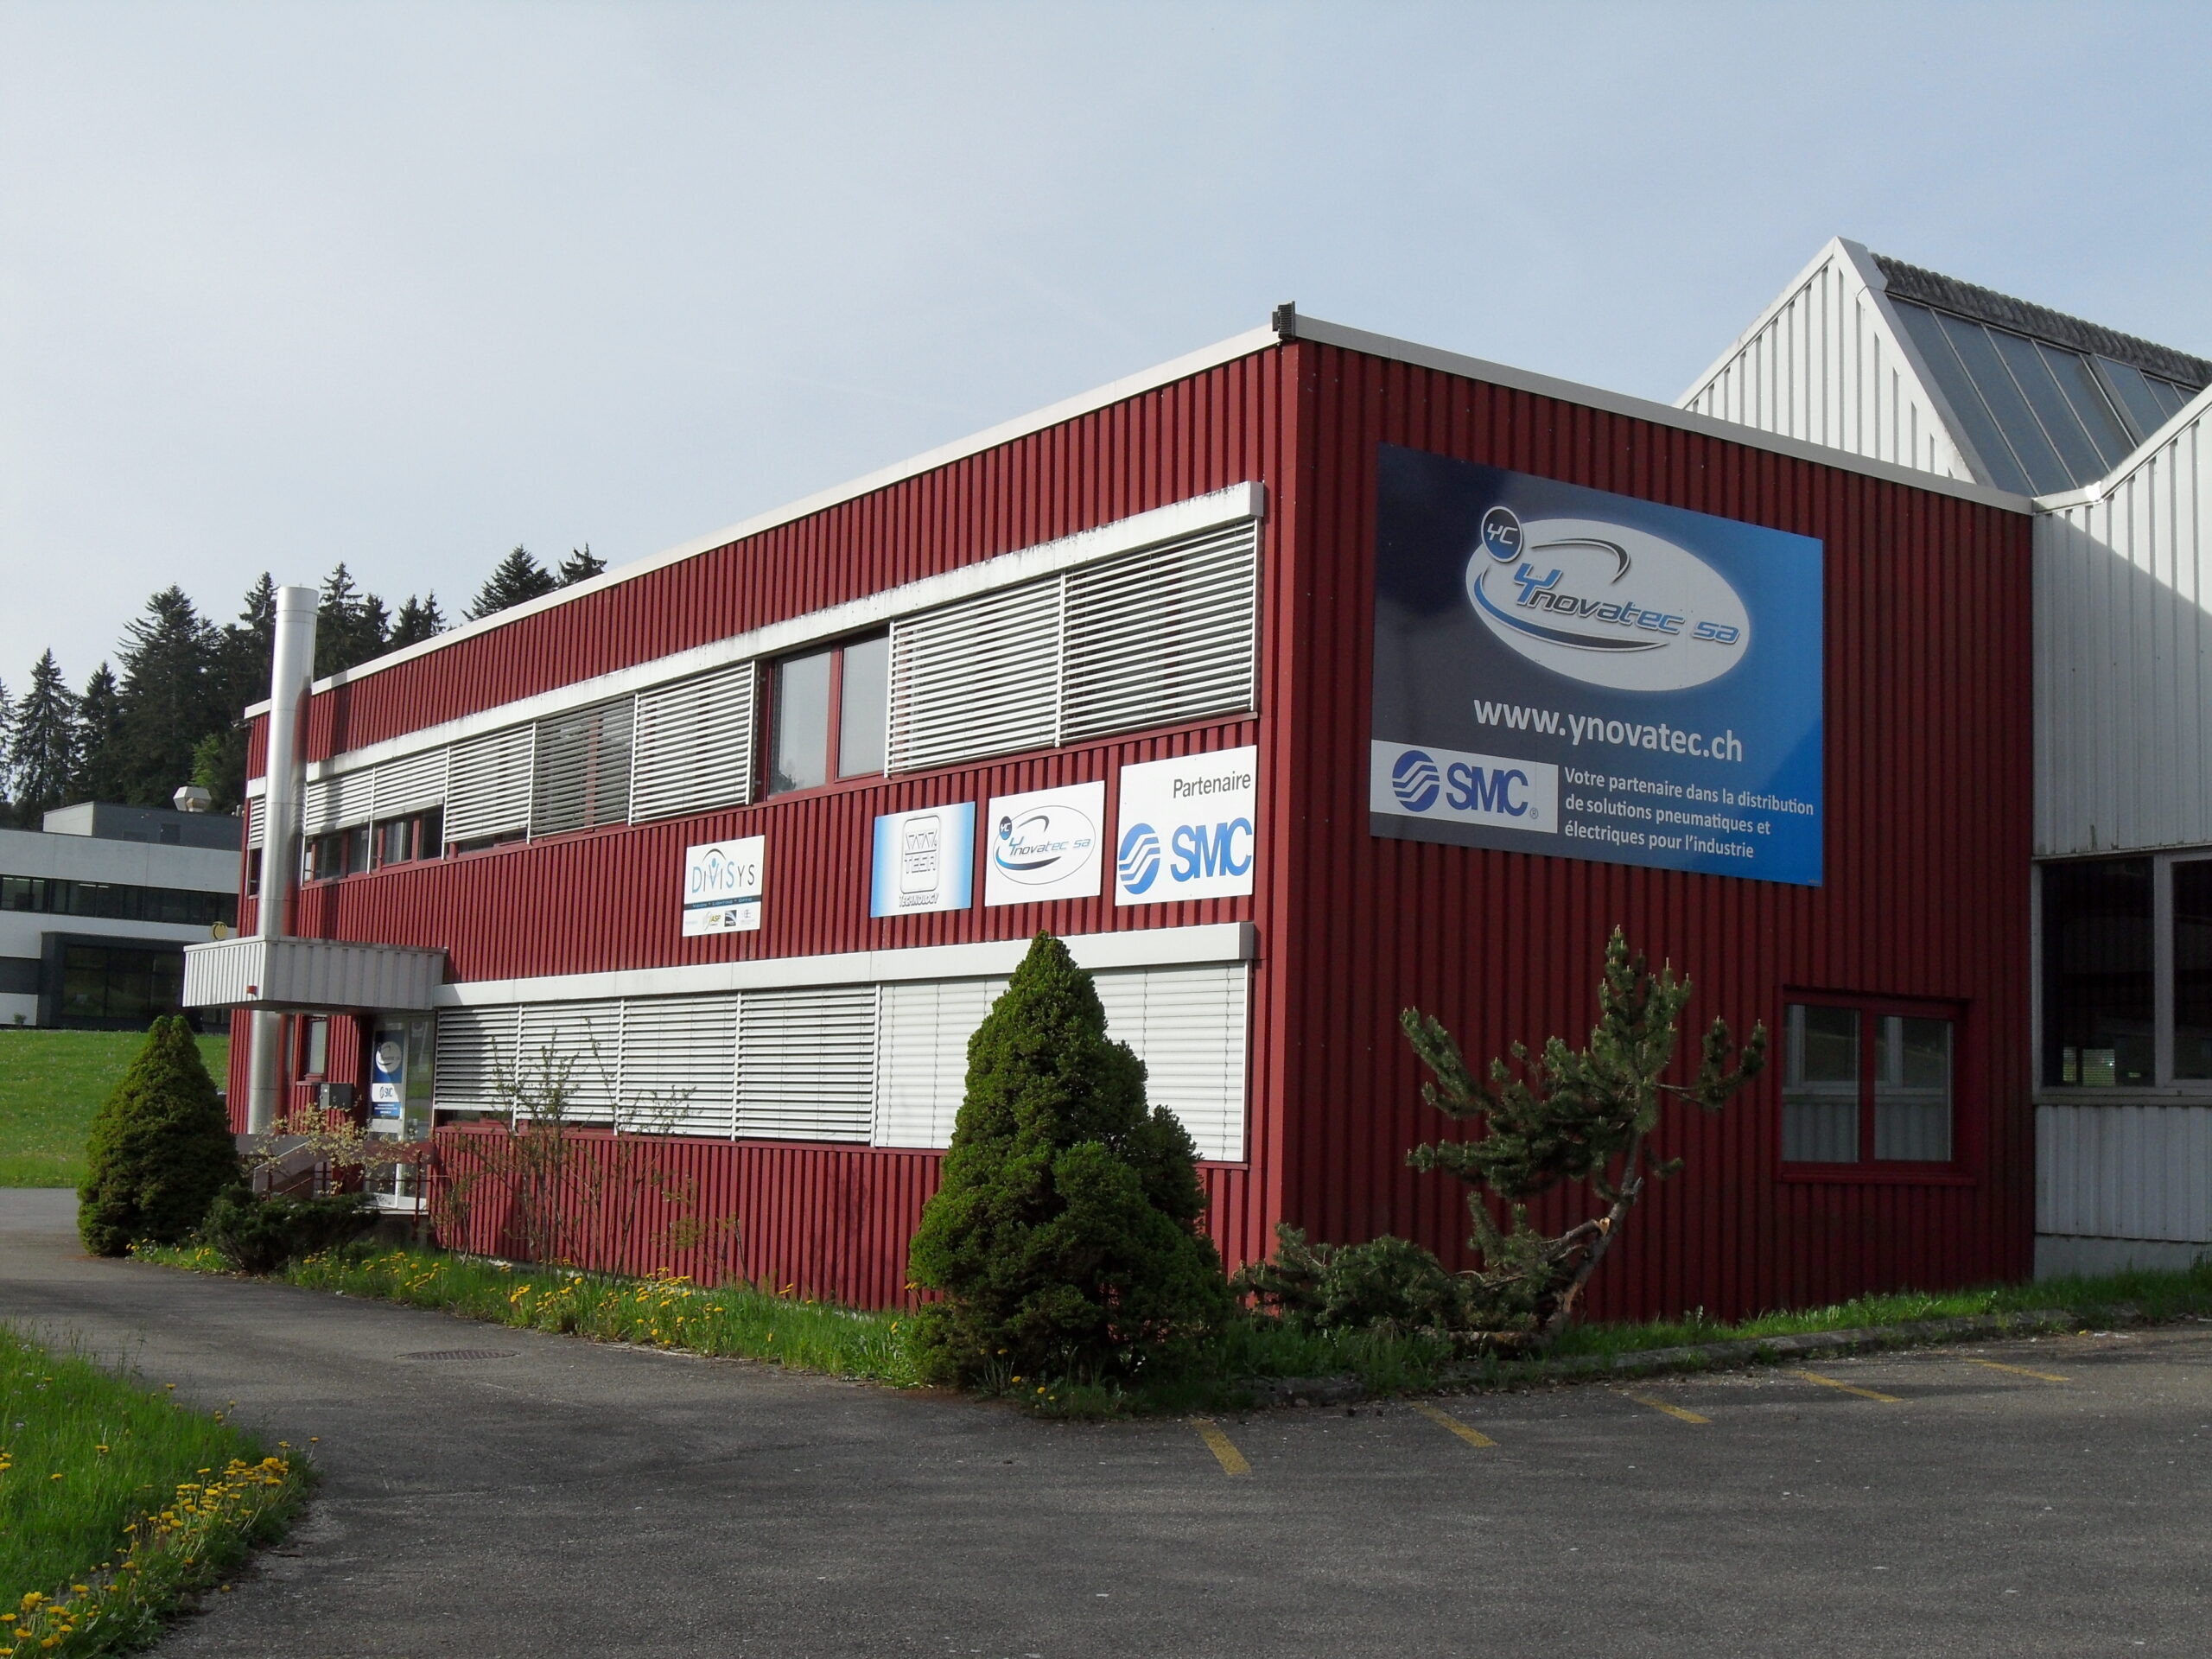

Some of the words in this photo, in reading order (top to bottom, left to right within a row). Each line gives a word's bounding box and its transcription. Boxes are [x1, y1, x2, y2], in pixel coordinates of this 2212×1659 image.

[1514, 563, 1684, 634] Ynovatec
[1693, 620, 1740, 644] sa
[1473, 699, 1743, 762] www.ynovatec.ch
[1173, 770, 1251, 798] Partenaire
[1446, 761, 1529, 817] SMC
[1564, 767, 1605, 787] Votre
[1609, 776, 1683, 798] partenaire
[1686, 784, 1719, 803] dans
[1722, 788, 1734, 804] la
[1738, 791, 1814, 816] distribution
[1564, 820, 1645, 846] électriques
[1649, 834, 1682, 850] pour
[1565, 793, 1584, 811] de
[1586, 798, 1652, 820] solutions
[1656, 808, 1753, 834] pneumatiques
[1757, 820, 1770, 835] et
[1009, 836, 1069, 855] Ynovatec
[1170, 817, 1253, 882] SMC
[899, 893, 939, 908] TECHNOLOGY
